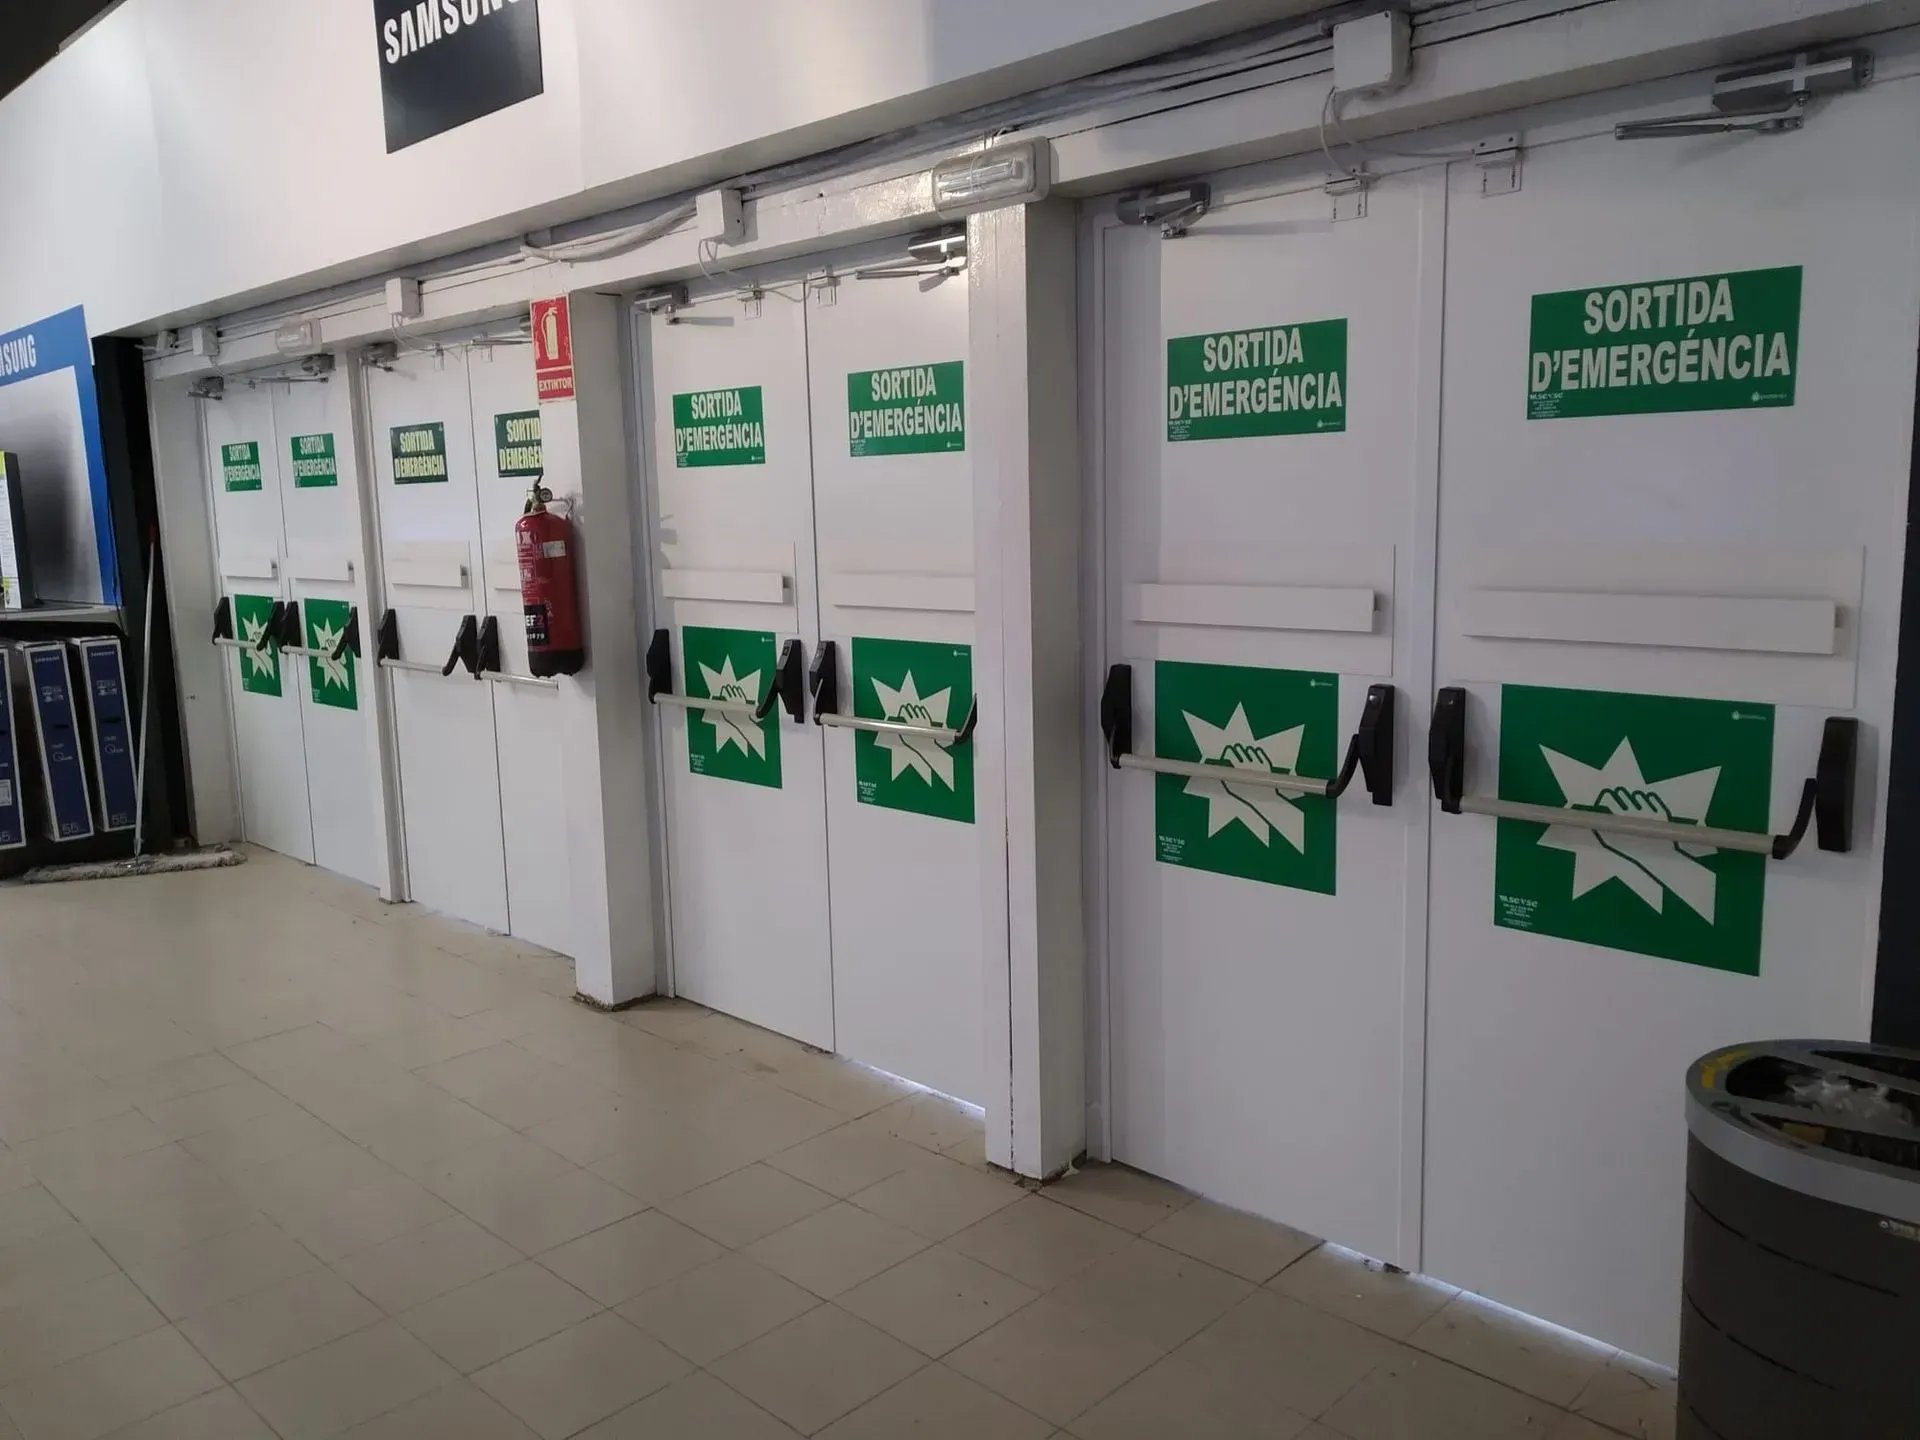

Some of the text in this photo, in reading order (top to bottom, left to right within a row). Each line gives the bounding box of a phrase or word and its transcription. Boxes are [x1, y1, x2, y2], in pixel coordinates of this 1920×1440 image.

[384, 0, 520, 64] SAMSU
[1584, 278, 1734, 335] SORTIDA
[1203, 328, 1303, 372] SORTIDA
[1532, 329, 1790, 392] D'EMERGÉNCIA
[540, 377, 573, 391] EXTINTOR
[872, 367, 936, 401] SORTIDA
[1169, 368, 1342, 419] D'EMERGÉNCIA
[691, 391, 742, 420] SORTIDA
[850, 399, 962, 439] D'EMERGÉNCIA
[400, 430, 435, 452] SORTIDA
[506, 417, 541, 442] SORTID
[676, 419, 763, 452] D'EMERGÉNCIA
